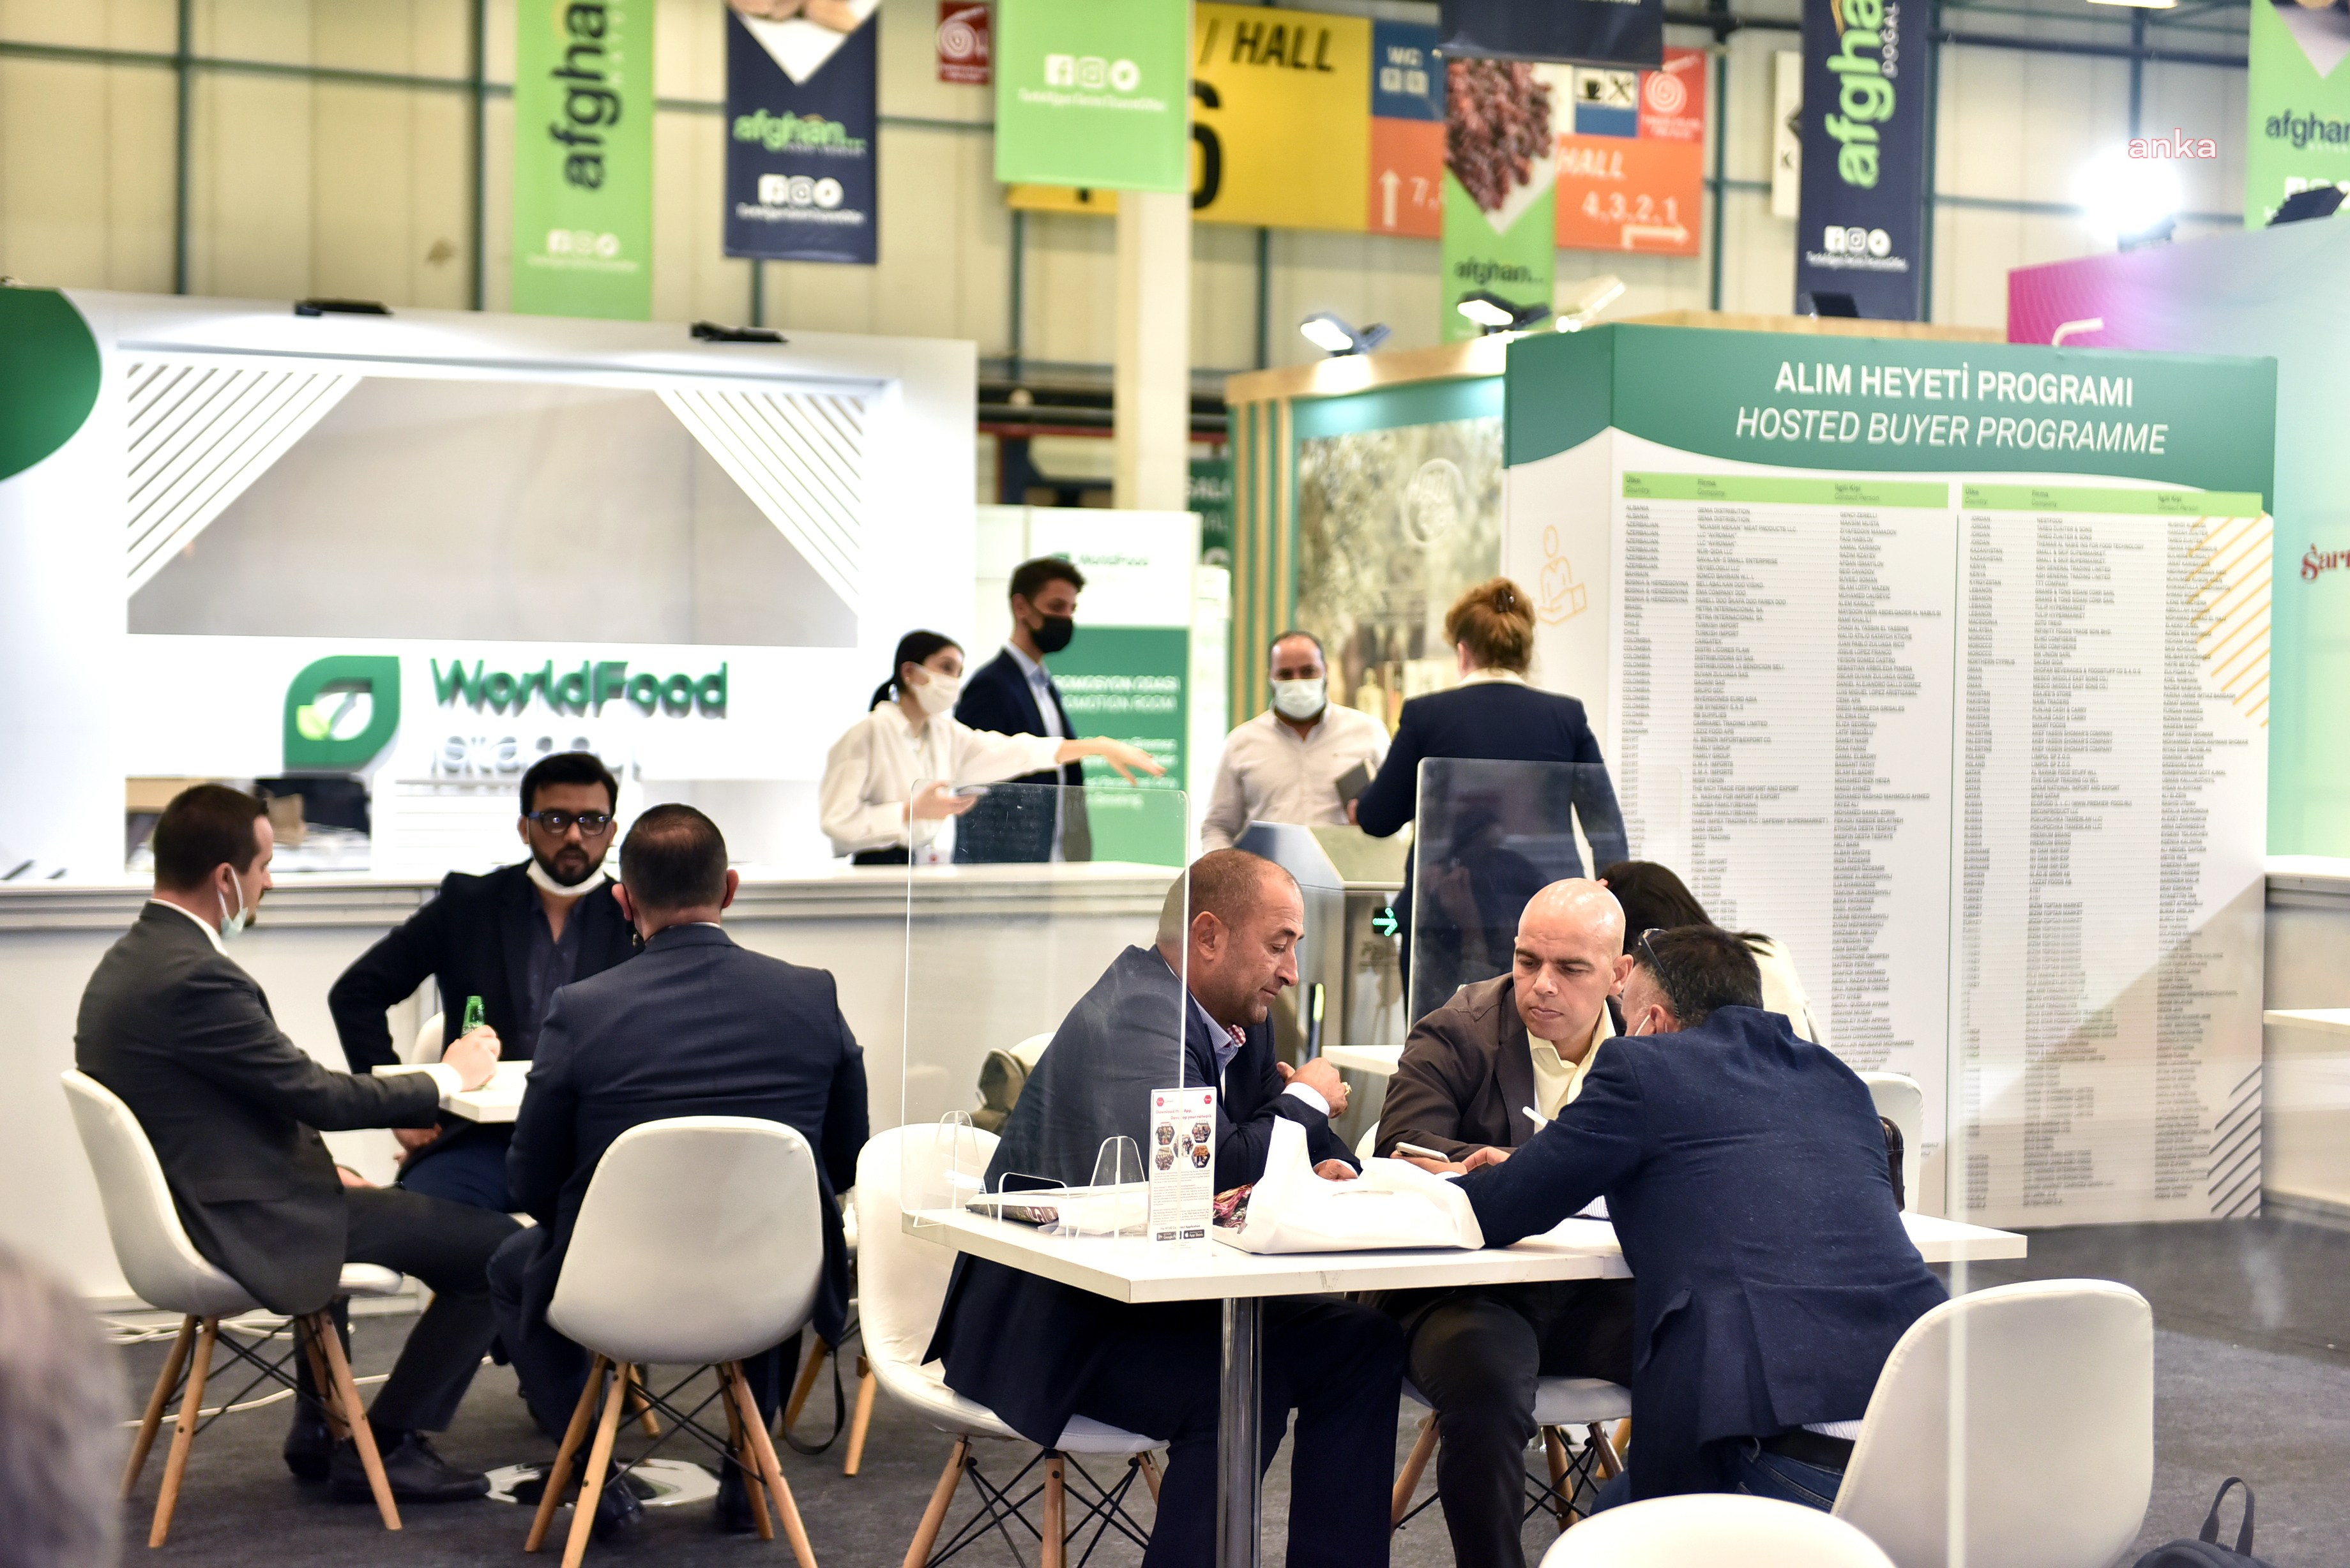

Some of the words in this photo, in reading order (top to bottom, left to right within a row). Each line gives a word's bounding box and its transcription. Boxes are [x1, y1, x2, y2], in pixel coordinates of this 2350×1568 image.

[1230, 20, 1335, 73] HALL
[1774, 361, 1851, 396] ALIM
[1860, 361, 1969, 401] HEYETİ
[1977, 370, 2133, 408] PROGRAMI
[1736, 406, 1861, 442] HOSTED
[1867, 412, 1969, 447] BUYER
[1976, 416, 2170, 455] PROGRAMME
[430, 658, 727, 718] WorldFood
